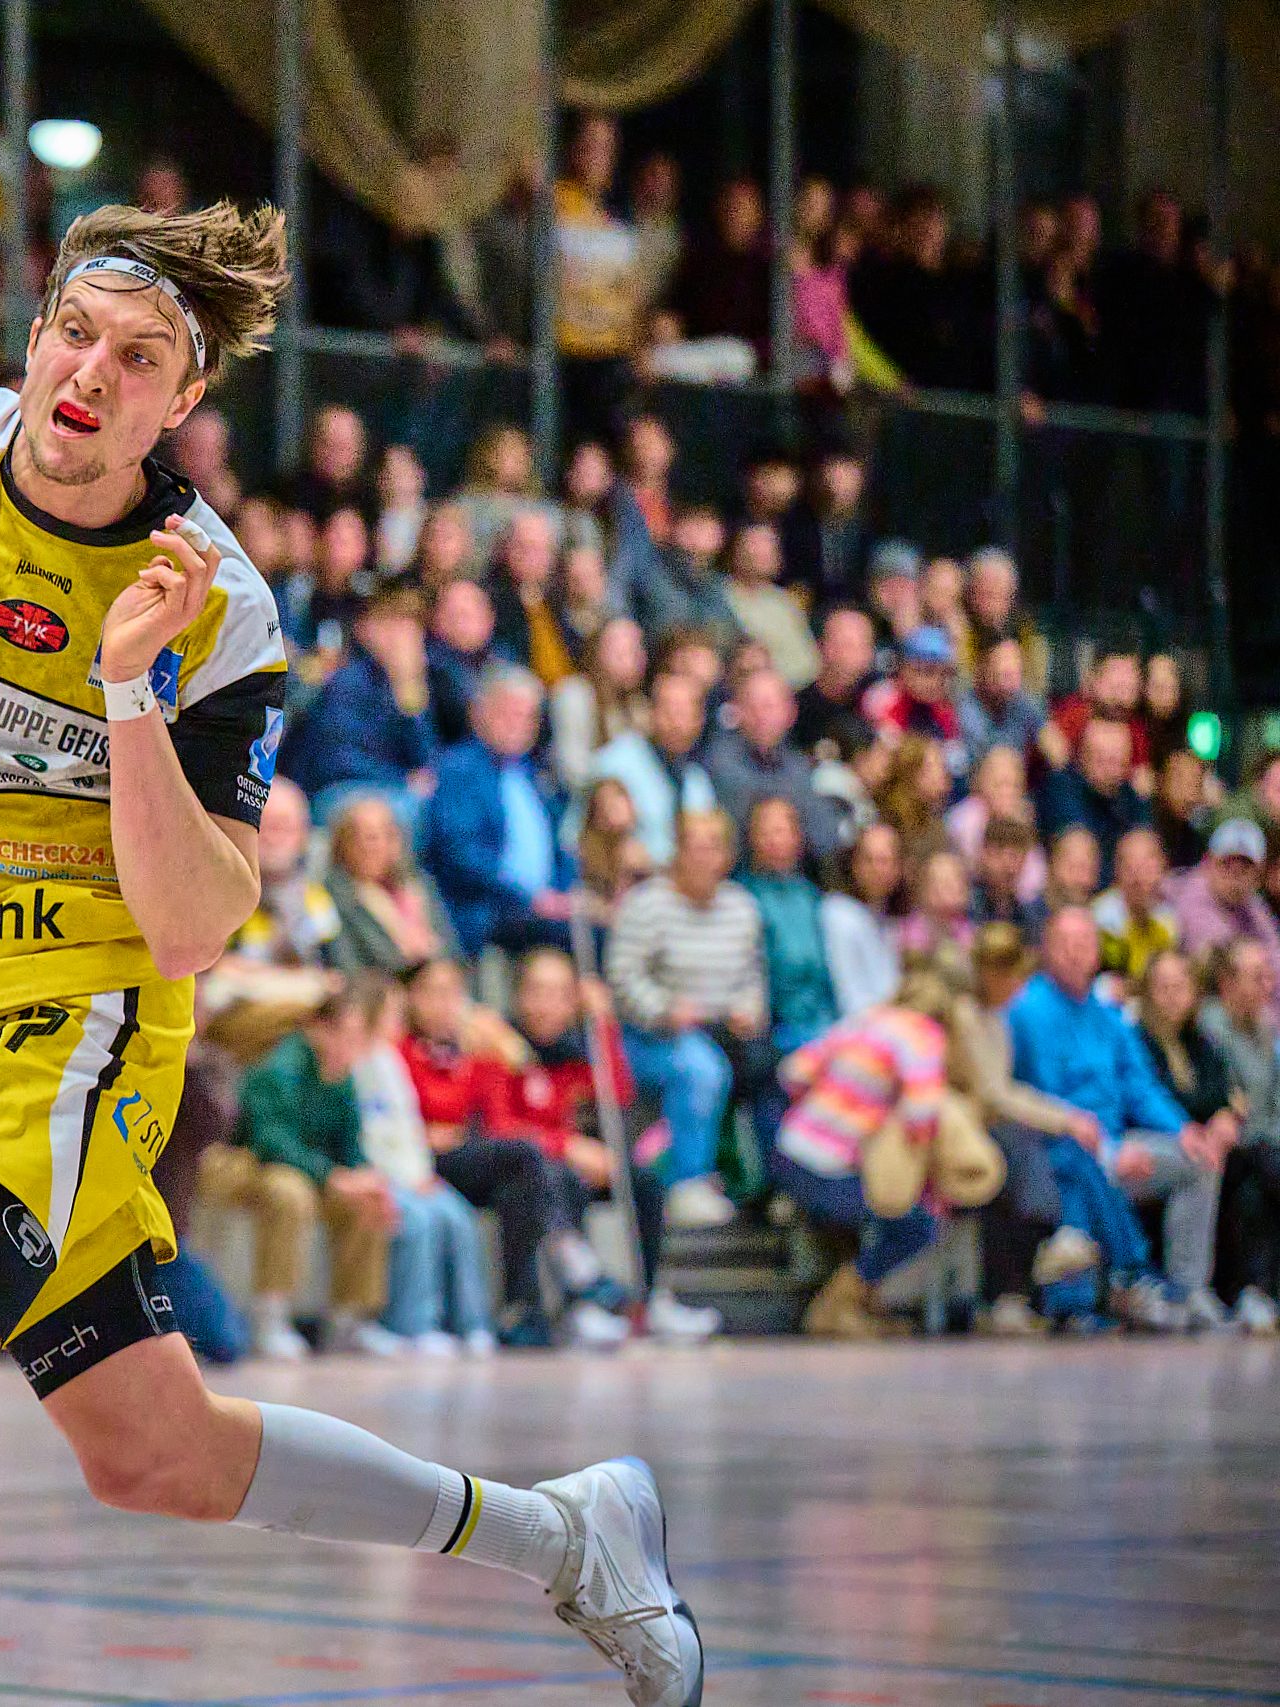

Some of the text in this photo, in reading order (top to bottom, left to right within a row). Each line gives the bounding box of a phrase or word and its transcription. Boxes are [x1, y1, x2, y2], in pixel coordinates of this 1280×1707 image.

[83, 260, 110, 271] NIKE
[15, 558, 73, 595] HALLENKIND
[13, 615, 48, 640] TVK
[57, 723, 110, 770] GEIS
[8, 865, 38, 879] zum
